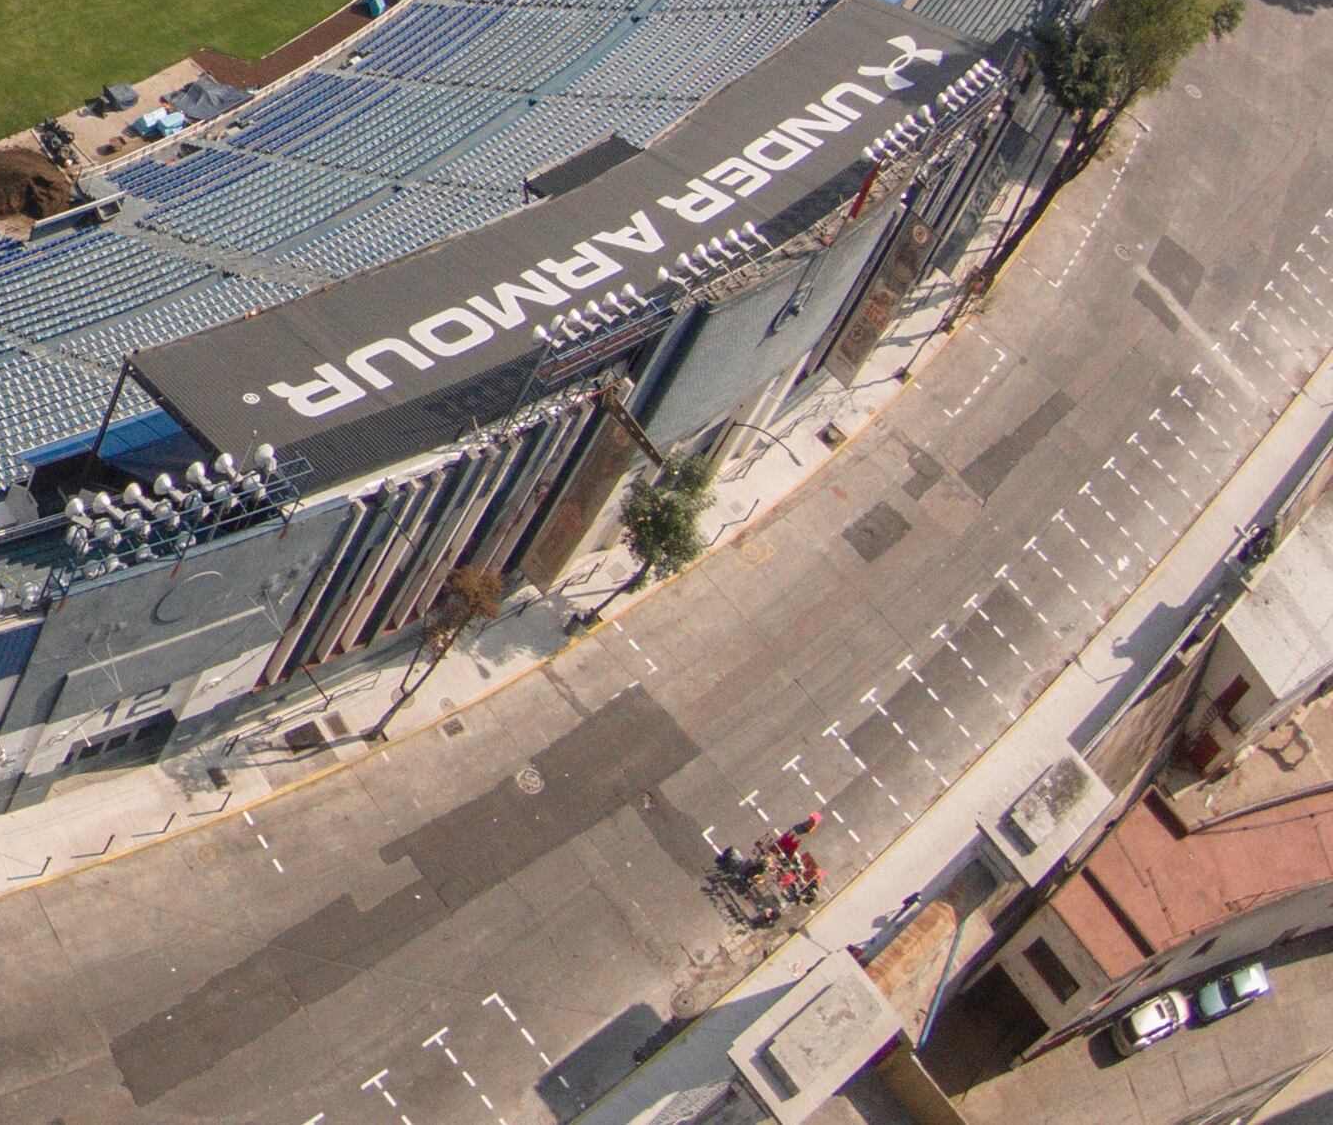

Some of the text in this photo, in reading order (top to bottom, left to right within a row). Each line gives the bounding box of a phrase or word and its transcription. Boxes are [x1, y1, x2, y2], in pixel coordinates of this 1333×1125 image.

[268, 82, 884, 418] UNDER ARMOUR
[103, 683, 172, 727] 12
